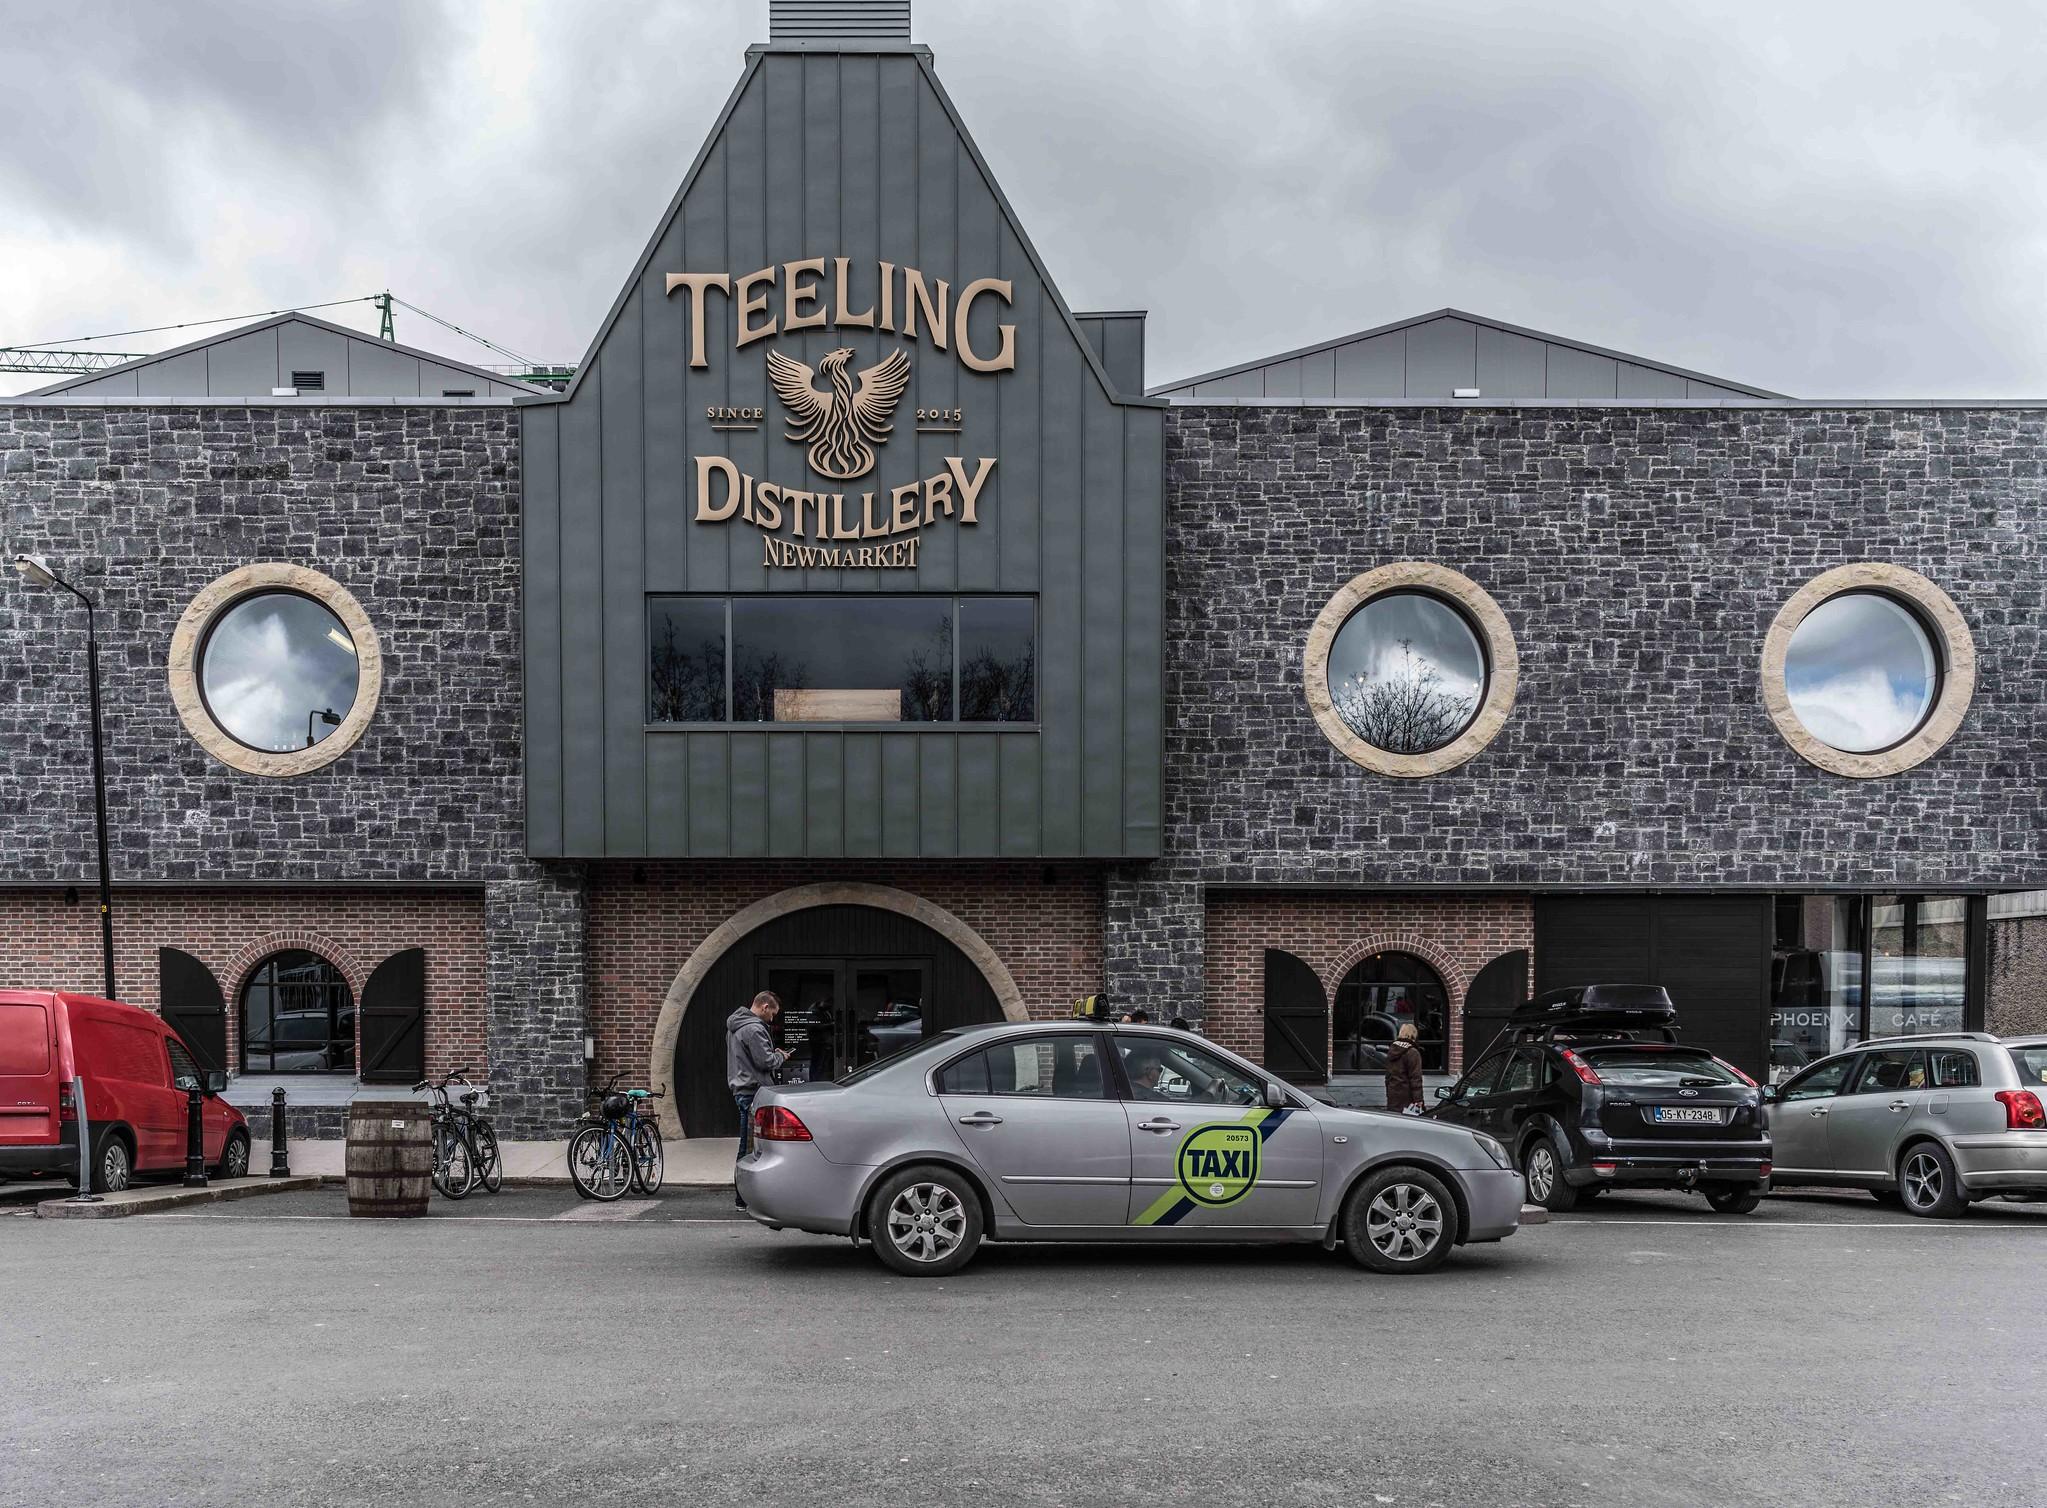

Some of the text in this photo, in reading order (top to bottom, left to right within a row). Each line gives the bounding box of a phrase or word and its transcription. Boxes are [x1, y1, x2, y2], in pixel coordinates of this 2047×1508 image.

[666, 257, 1016, 372] TEELING
[707, 406, 962, 421] SINCE 2015
[694, 455, 997, 540] DISTILLERY
[763, 535, 920, 568] NEWMARKET
[1769, 1009, 1941, 1026] PHOENX CAFÉ
[1661, 1109, 1713, 1121] 05-KY-2348
[1226, 1134, 1249, 1142] 20573
[1187, 1149, 1250, 1178] TAXI
